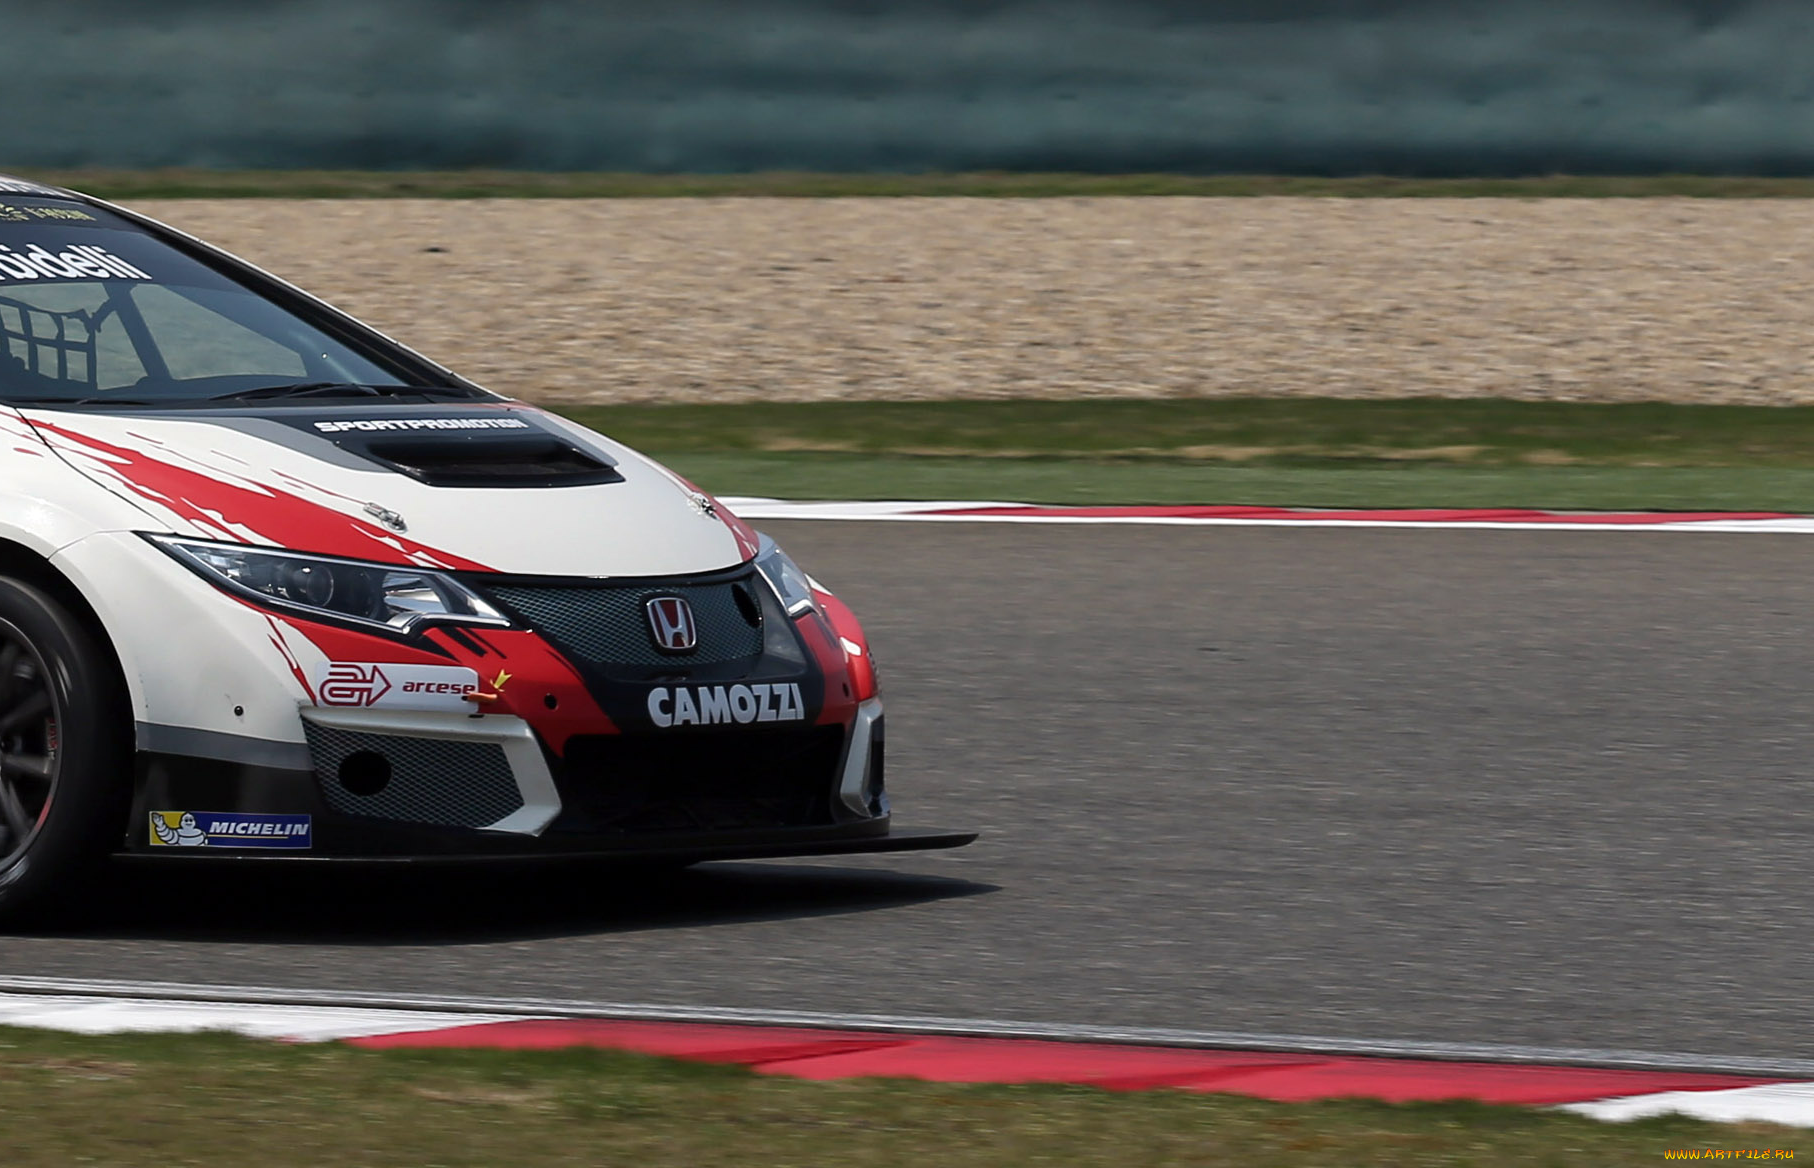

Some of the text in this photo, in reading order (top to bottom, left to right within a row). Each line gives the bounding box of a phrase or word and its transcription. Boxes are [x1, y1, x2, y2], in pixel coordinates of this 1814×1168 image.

[314, 418, 528, 432] SPORTPROMOTION
[402, 681, 476, 695] arcese
[647, 683, 805, 728] CAMOZZI
[209, 821, 309, 836] MICHELIN
